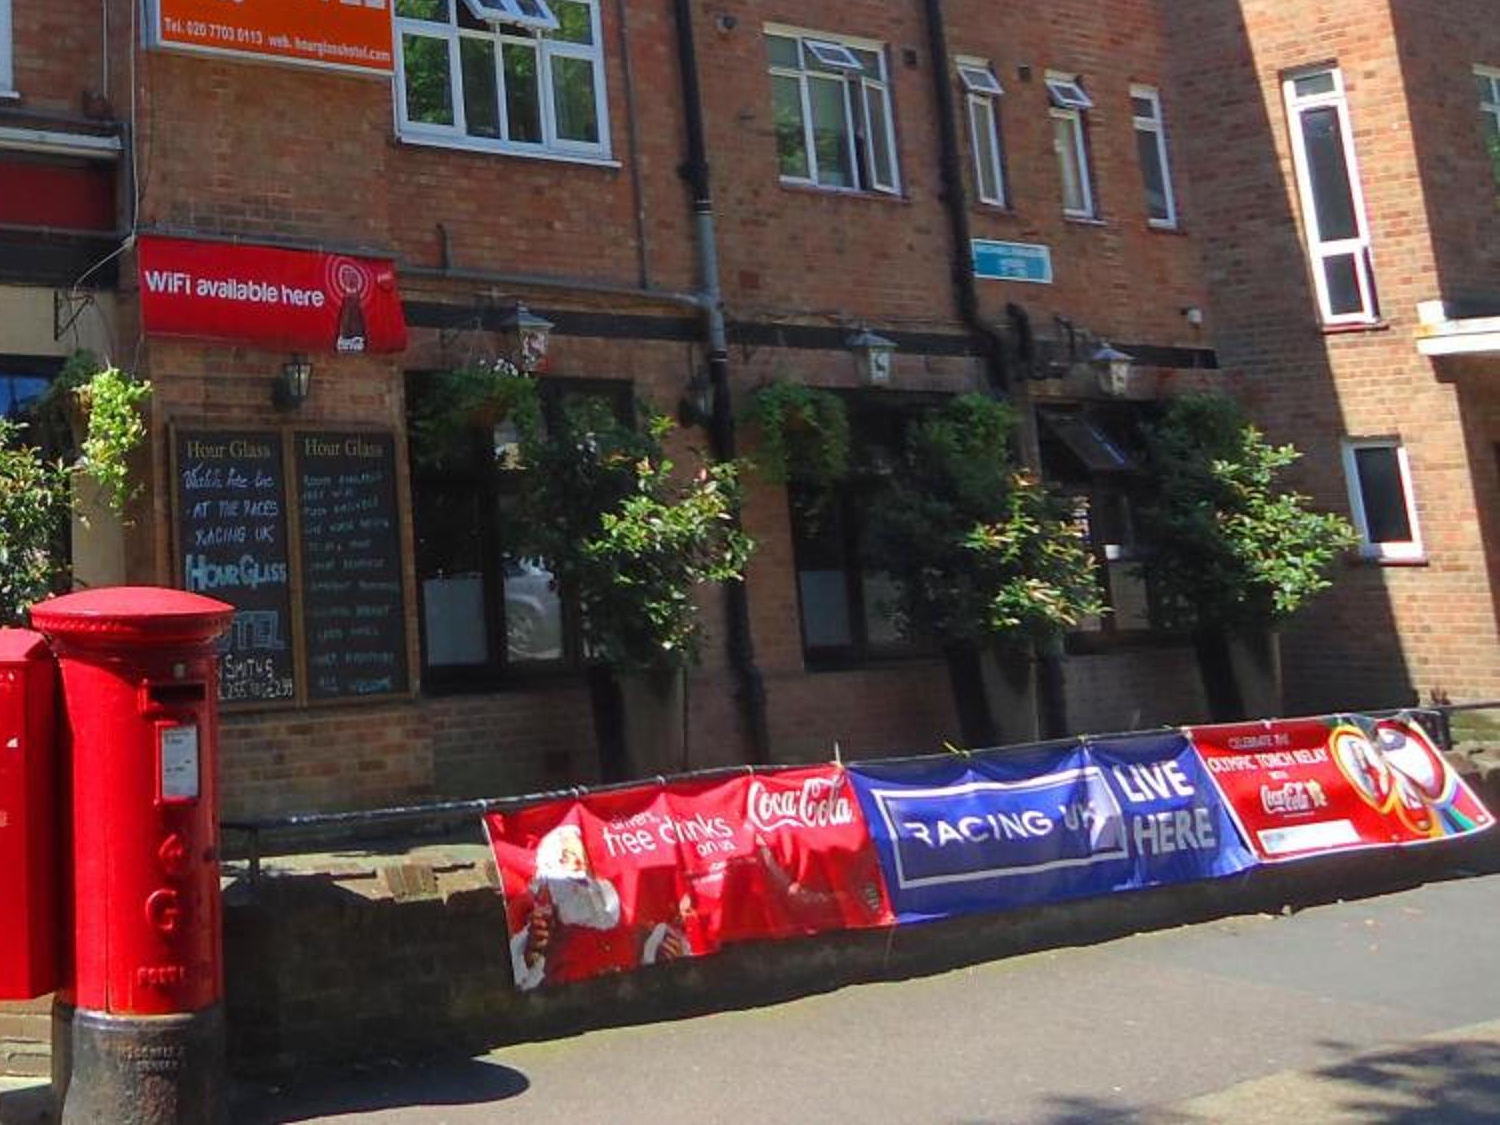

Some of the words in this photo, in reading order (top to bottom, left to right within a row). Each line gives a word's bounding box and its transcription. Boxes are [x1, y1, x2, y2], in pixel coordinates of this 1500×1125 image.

[196, 276, 278, 303] available
[282, 283, 325, 308] here
[187, 440, 227, 458] Hour
[229, 440, 270, 459] Glass
[304, 438, 340, 456] Hour
[344, 438, 383, 458] Glass
[1207, 754, 1257, 773] OLYMPIC
[1256, 751, 1292, 768] TORCH
[1292, 746, 1328, 764] RELAY
[1112, 760, 1195, 802] LIVE
[747, 777, 853, 832] Coca-Cola
[603, 827, 656, 857] free
[658, 813, 734, 845] drinks
[904, 811, 1053, 847] RACING
[1133, 808, 1216, 855] HERE
[696, 841, 718, 856] on
